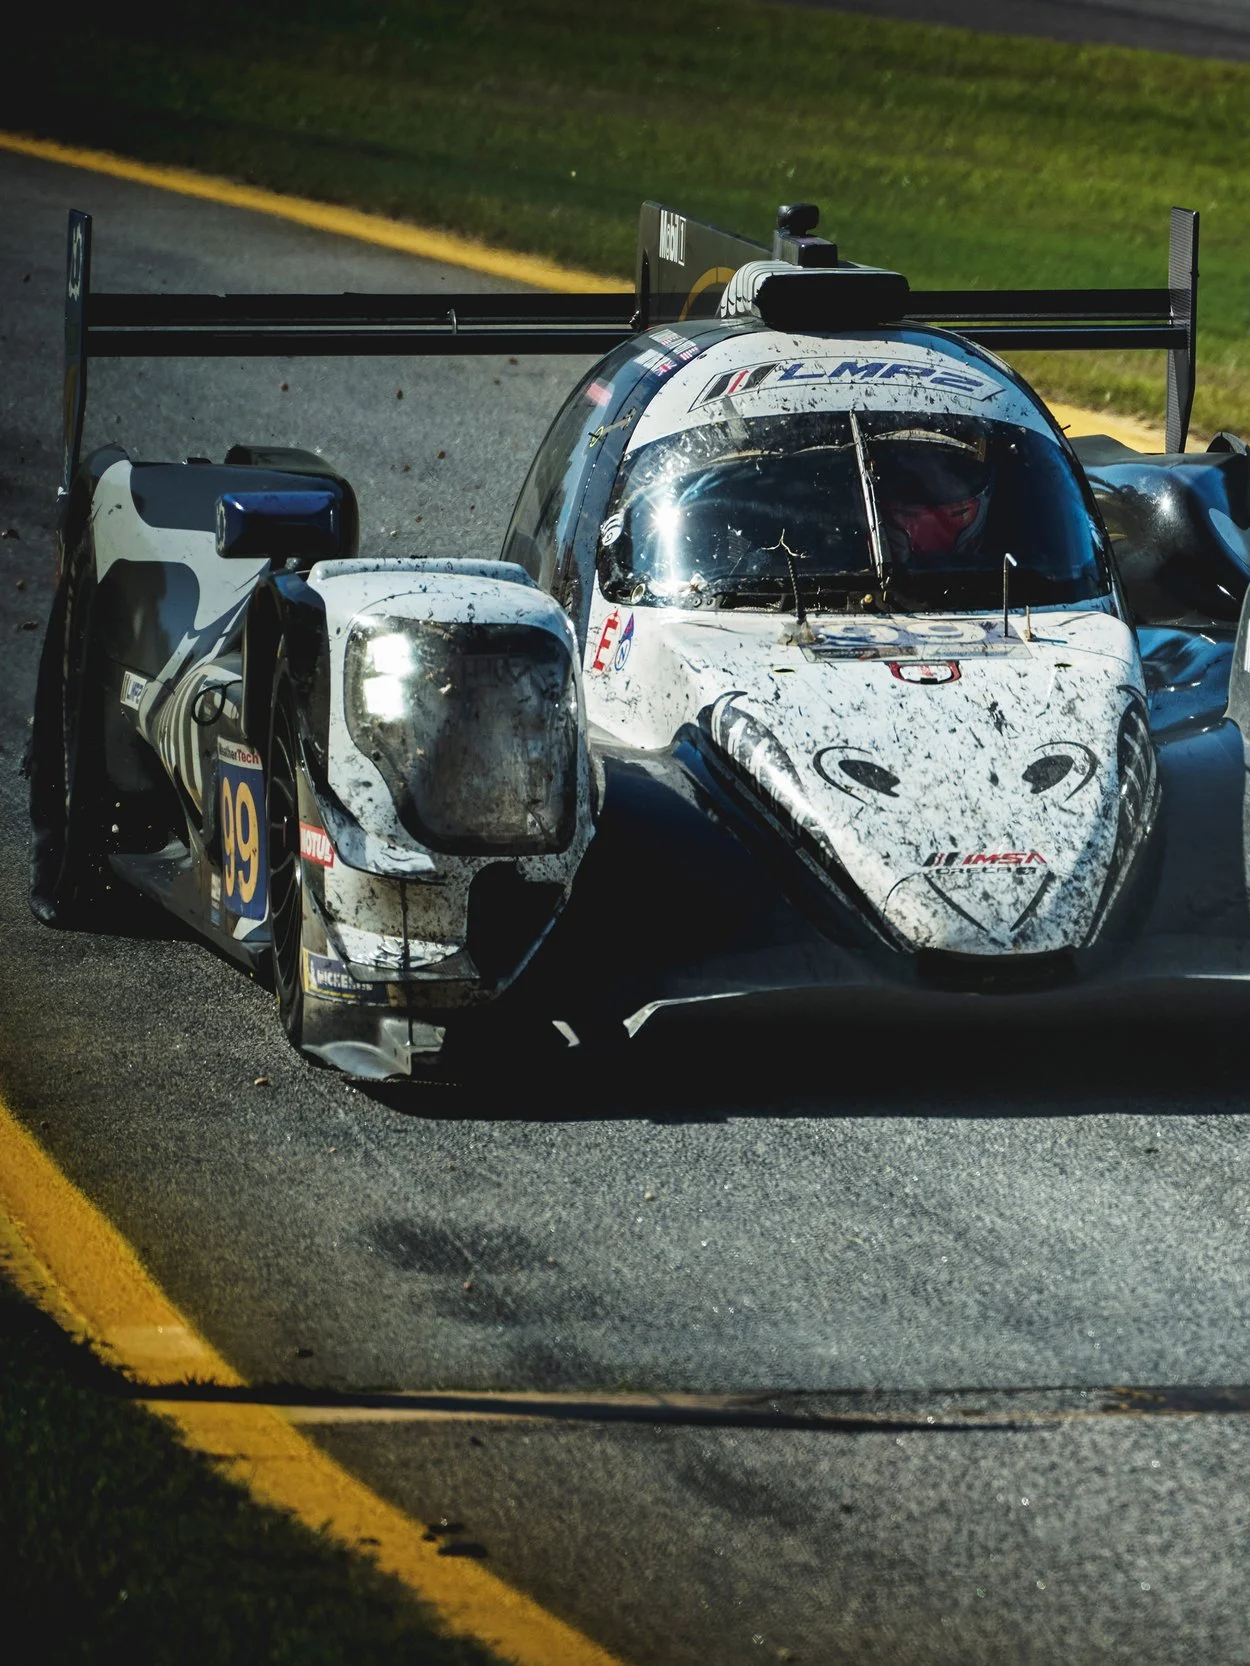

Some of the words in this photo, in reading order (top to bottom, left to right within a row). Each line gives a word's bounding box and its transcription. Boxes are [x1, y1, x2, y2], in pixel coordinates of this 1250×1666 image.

[659, 209, 680, 263] Mobil
[777, 361, 984, 392] LMP2
[222, 776, 260, 903] 99
[962, 851, 1048, 865] IMSA
